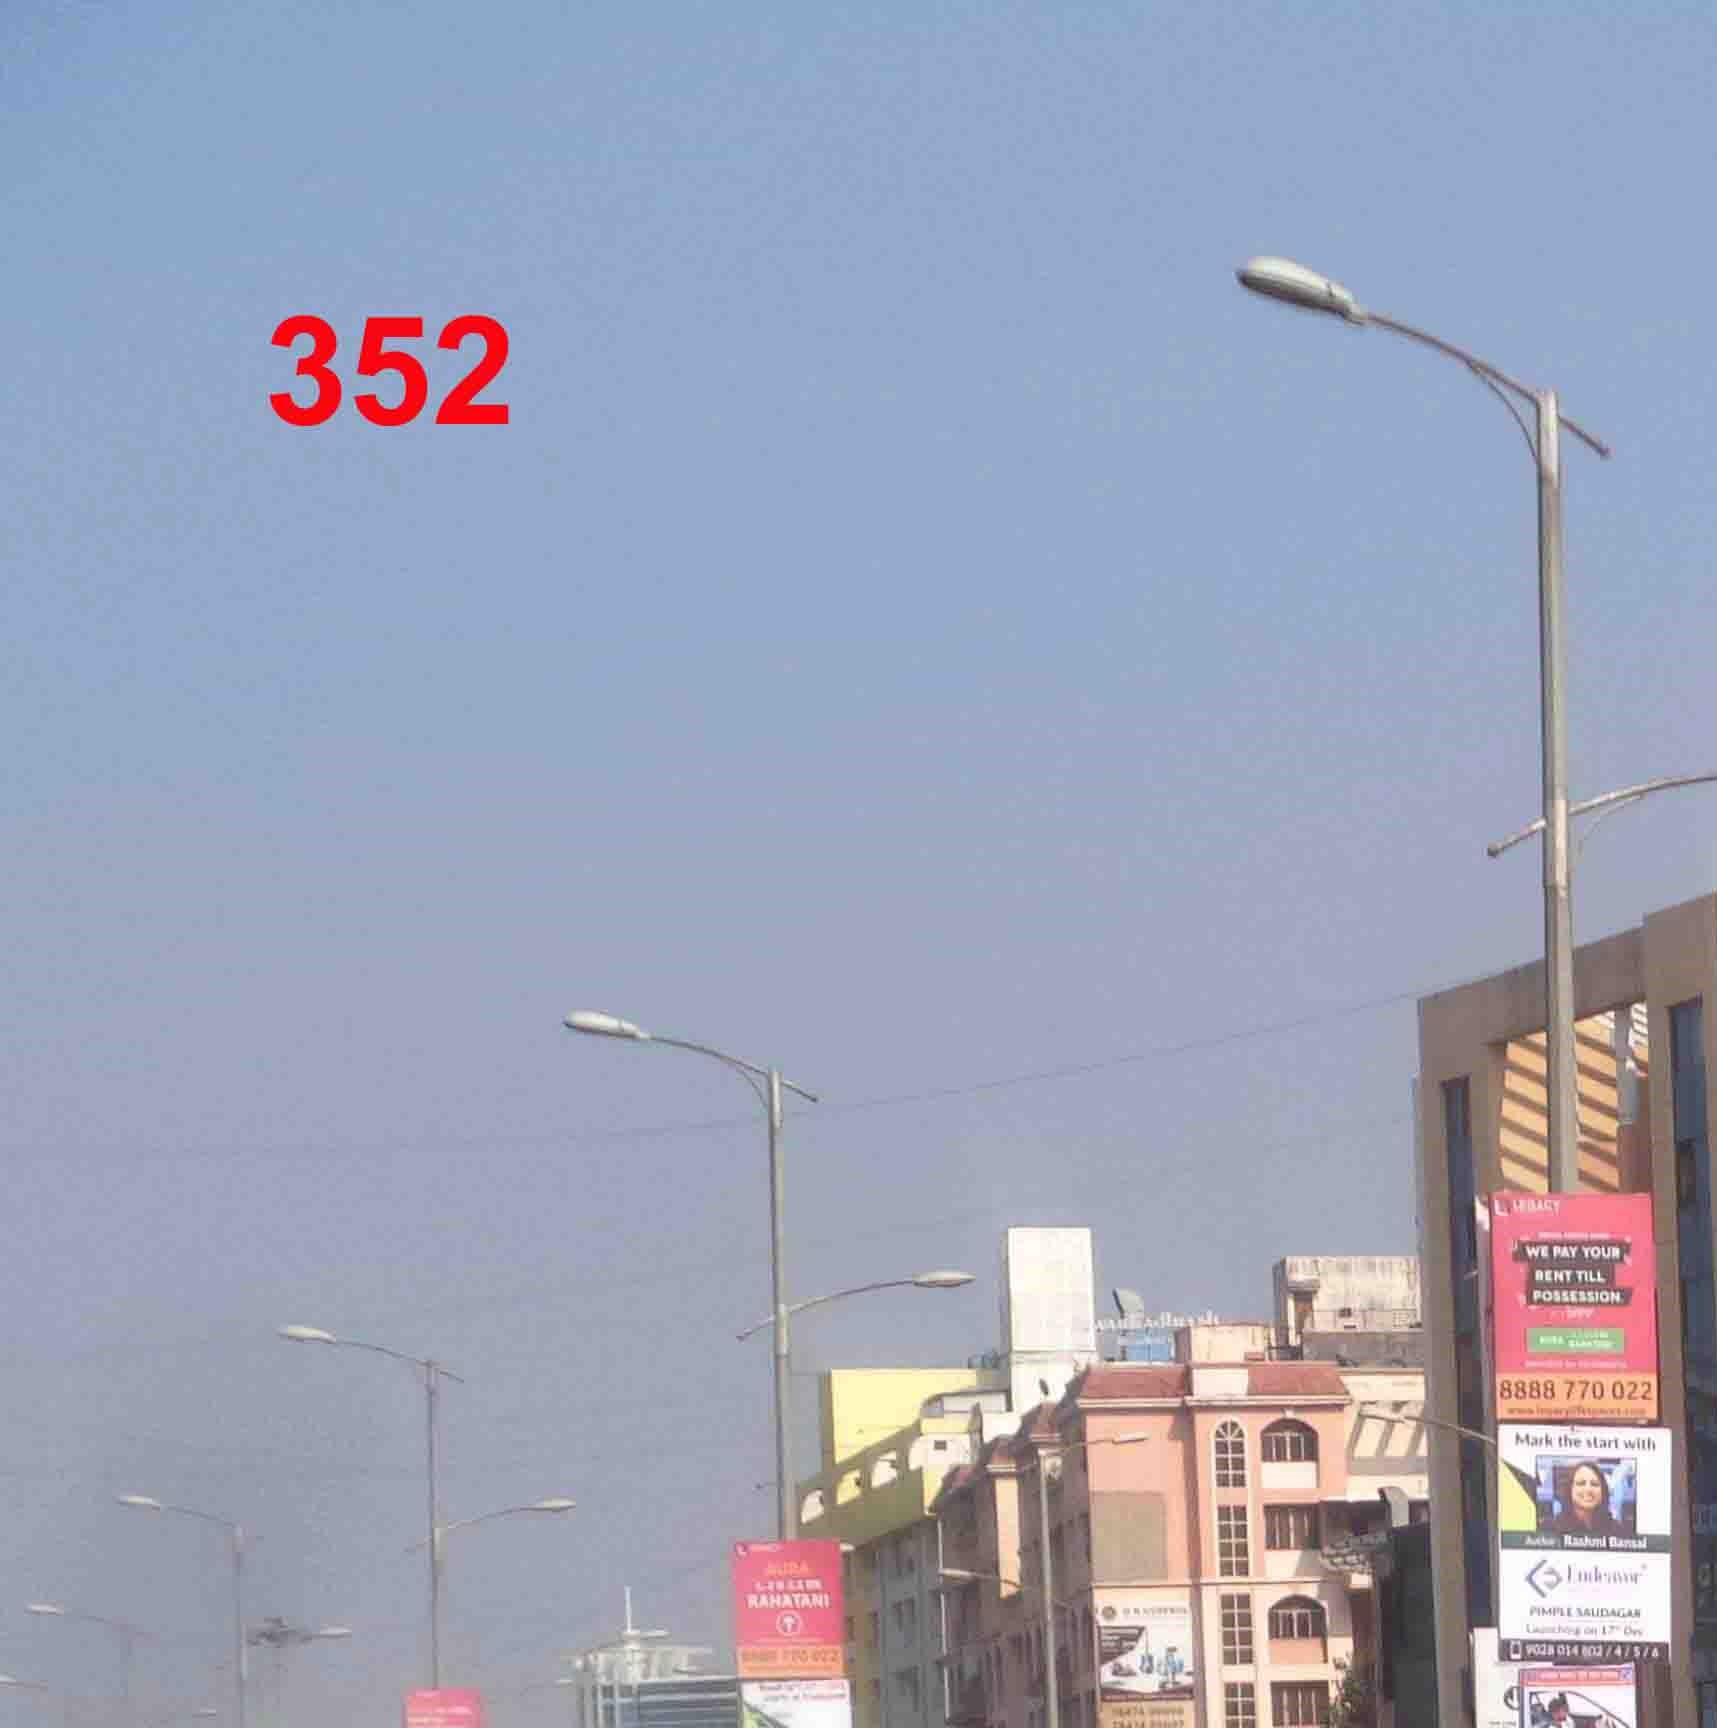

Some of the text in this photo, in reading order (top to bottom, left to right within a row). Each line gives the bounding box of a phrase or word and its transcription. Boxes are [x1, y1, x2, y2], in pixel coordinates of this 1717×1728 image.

[1525, 1245, 1621, 1260] WE PAY YOUR
[1535, 1269, 1606, 1283] RENT TILL
[1500, 1379, 1653, 1401] 8888 770 022
[1515, 1431, 1656, 1452] Mark the start with
[1563, 1535, 1607, 1549] Rashmi
[1609, 1536, 1648, 1550] Bansal
[1529, 1606, 1642, 1619] PIMPLE SAUDAGAR
[1525, 1624, 1581, 1638] Launching
[1583, 1626, 1598, 1638] on
[1557, 1644, 1579, 1657] 014
